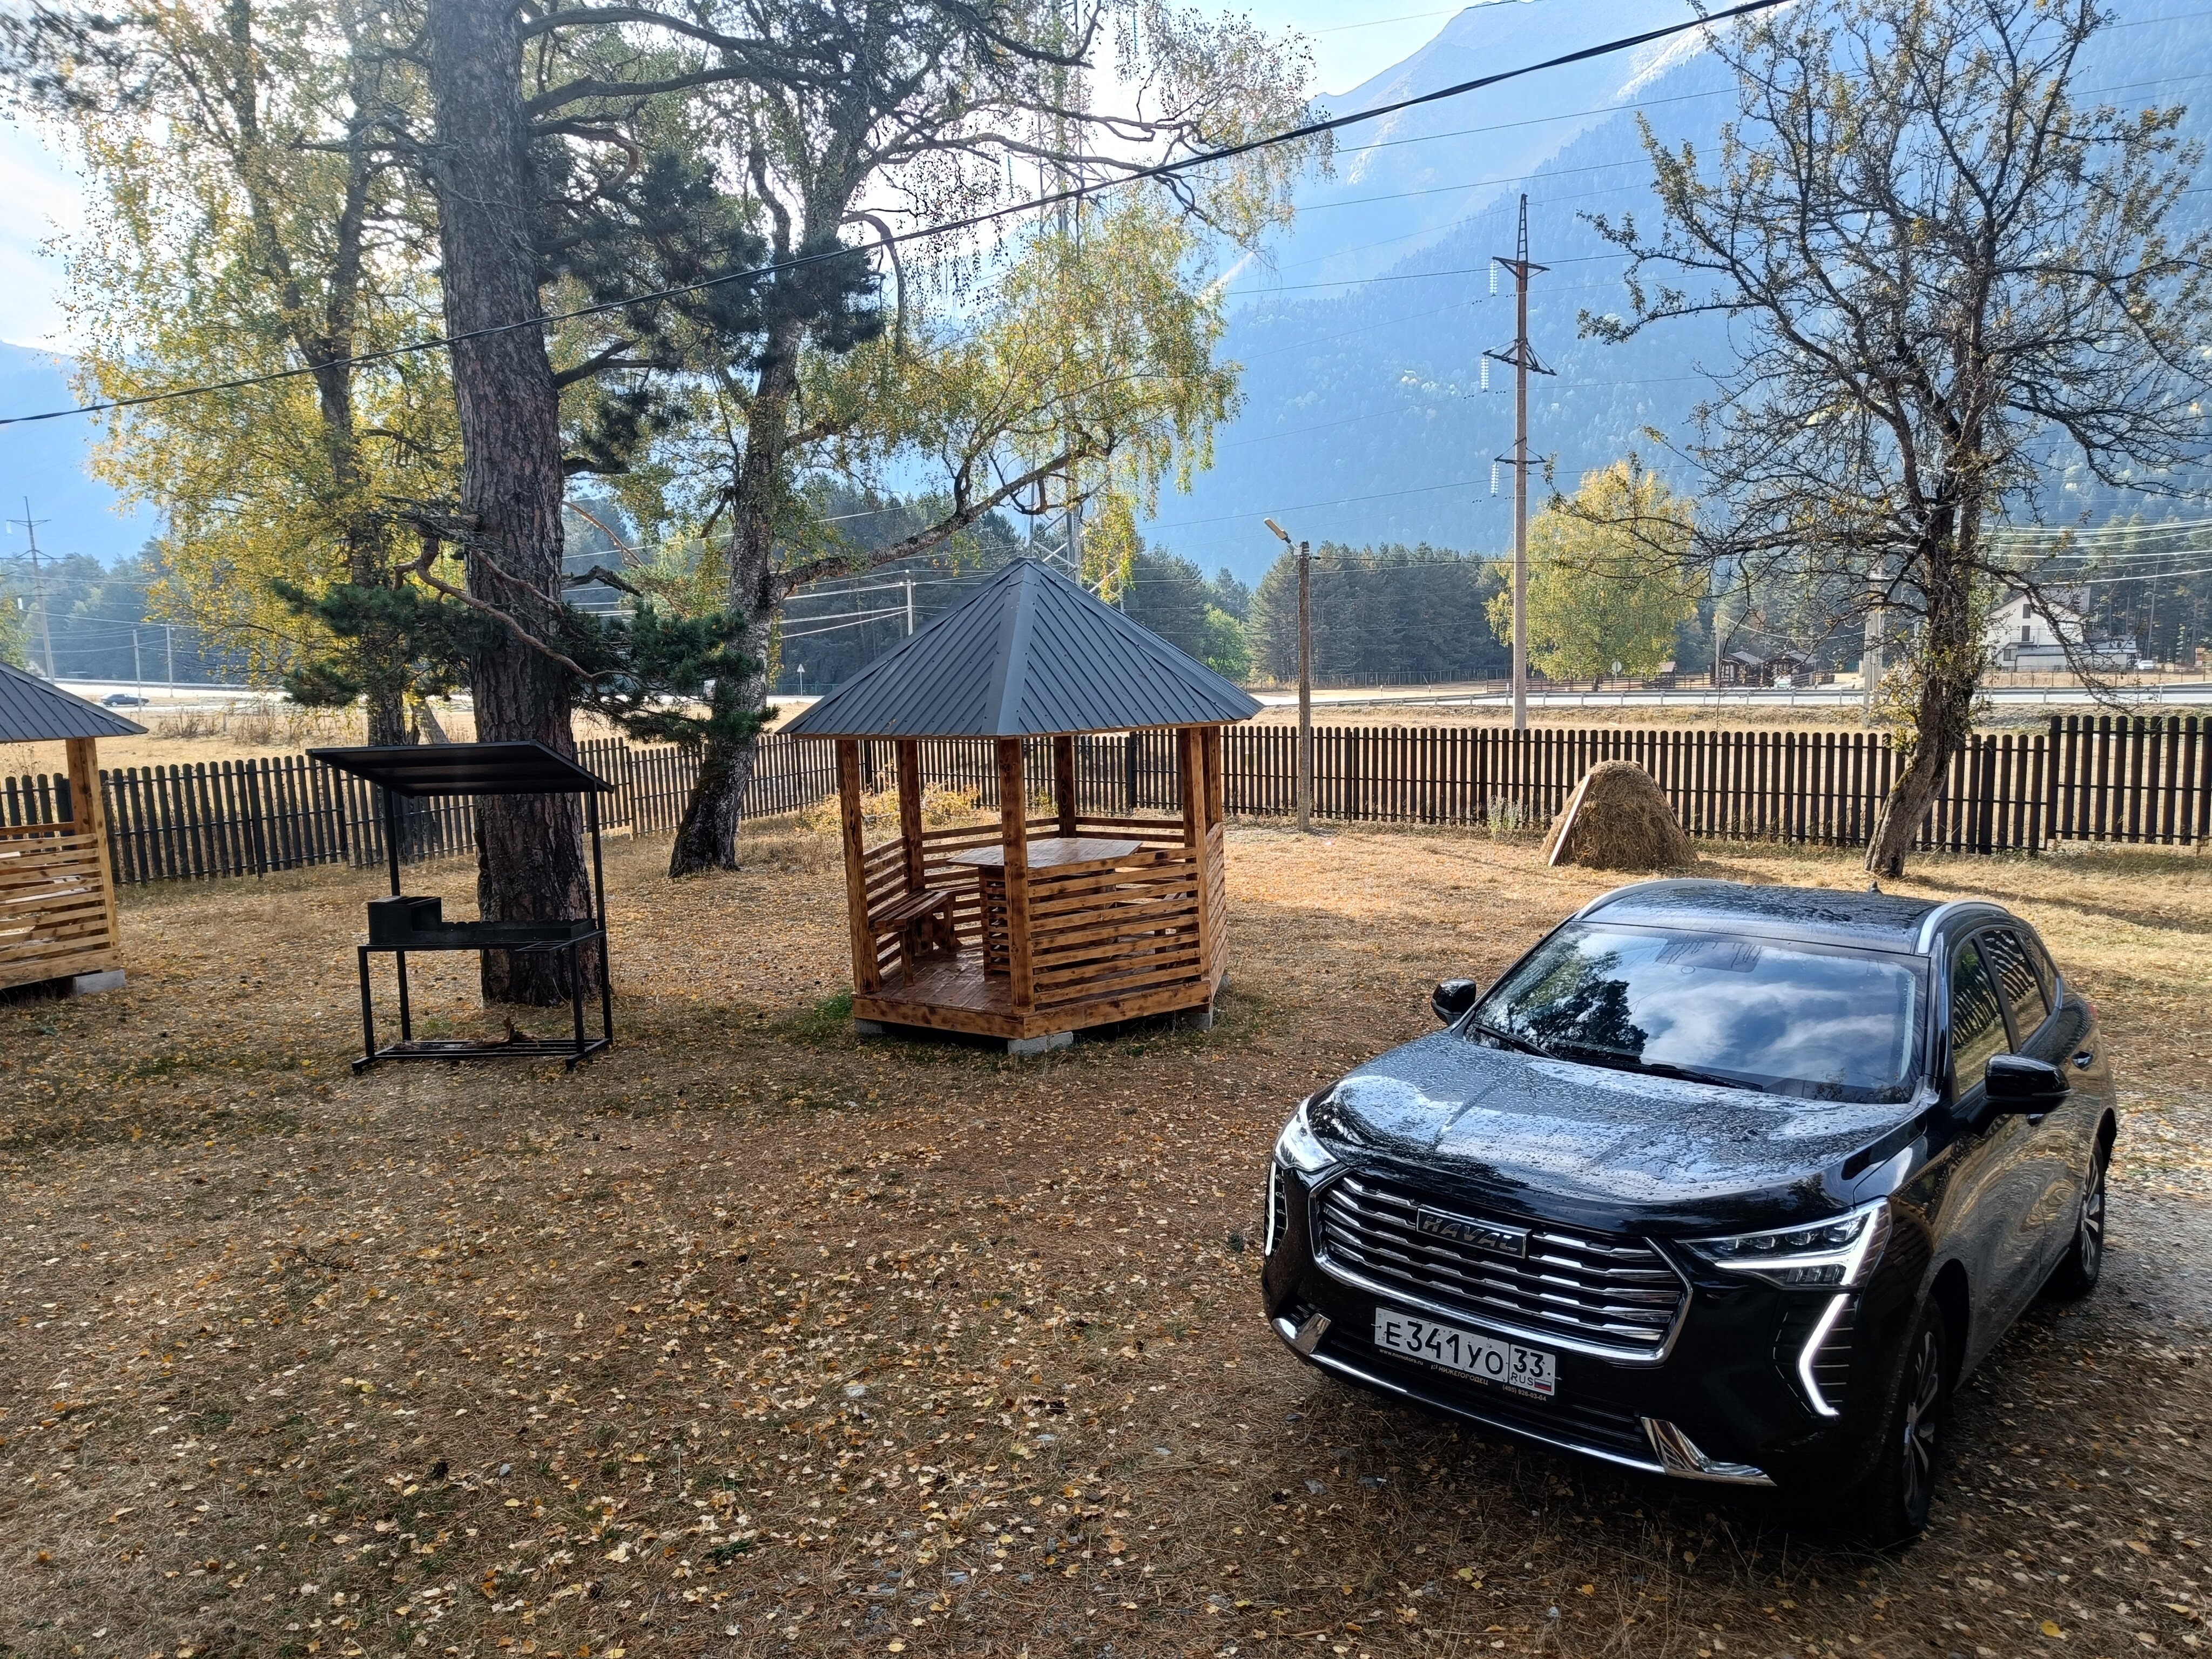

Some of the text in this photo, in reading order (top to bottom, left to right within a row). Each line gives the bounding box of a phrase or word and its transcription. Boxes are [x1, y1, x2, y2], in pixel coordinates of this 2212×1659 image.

[1422, 1215, 1518, 1252] HAVAL
[1438, 1366, 1488, 1386] НИЖЕГОРОДЕЦ
[1511, 1372, 1534, 1386] RUS
